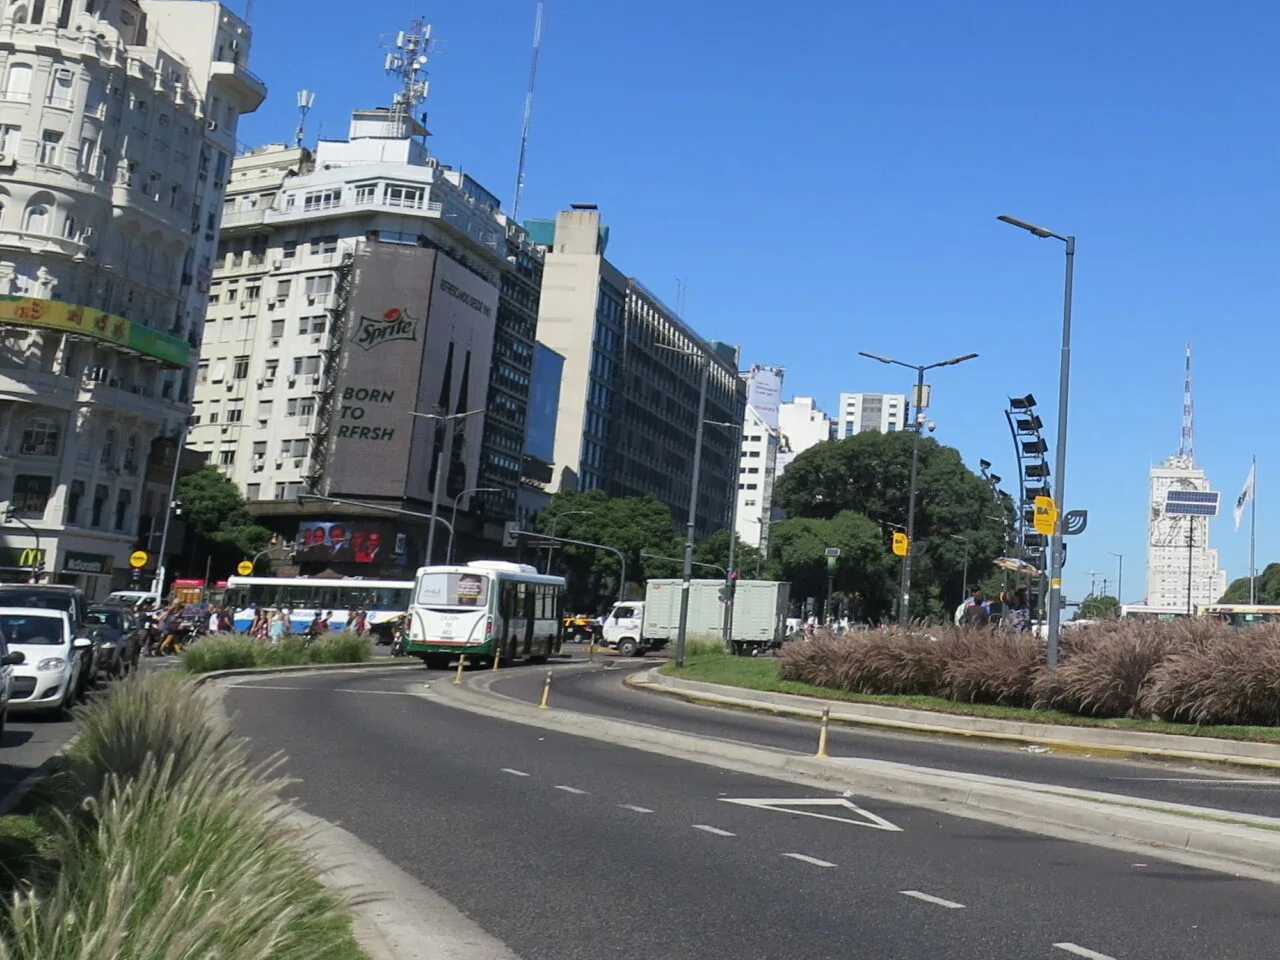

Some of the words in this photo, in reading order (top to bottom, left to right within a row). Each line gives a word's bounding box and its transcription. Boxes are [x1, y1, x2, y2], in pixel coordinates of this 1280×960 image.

[359, 316, 412, 345] Sprite
[342, 386, 396, 403] BORN
[341, 406, 365, 420] TO
[337, 425, 395, 441] RFRSH
